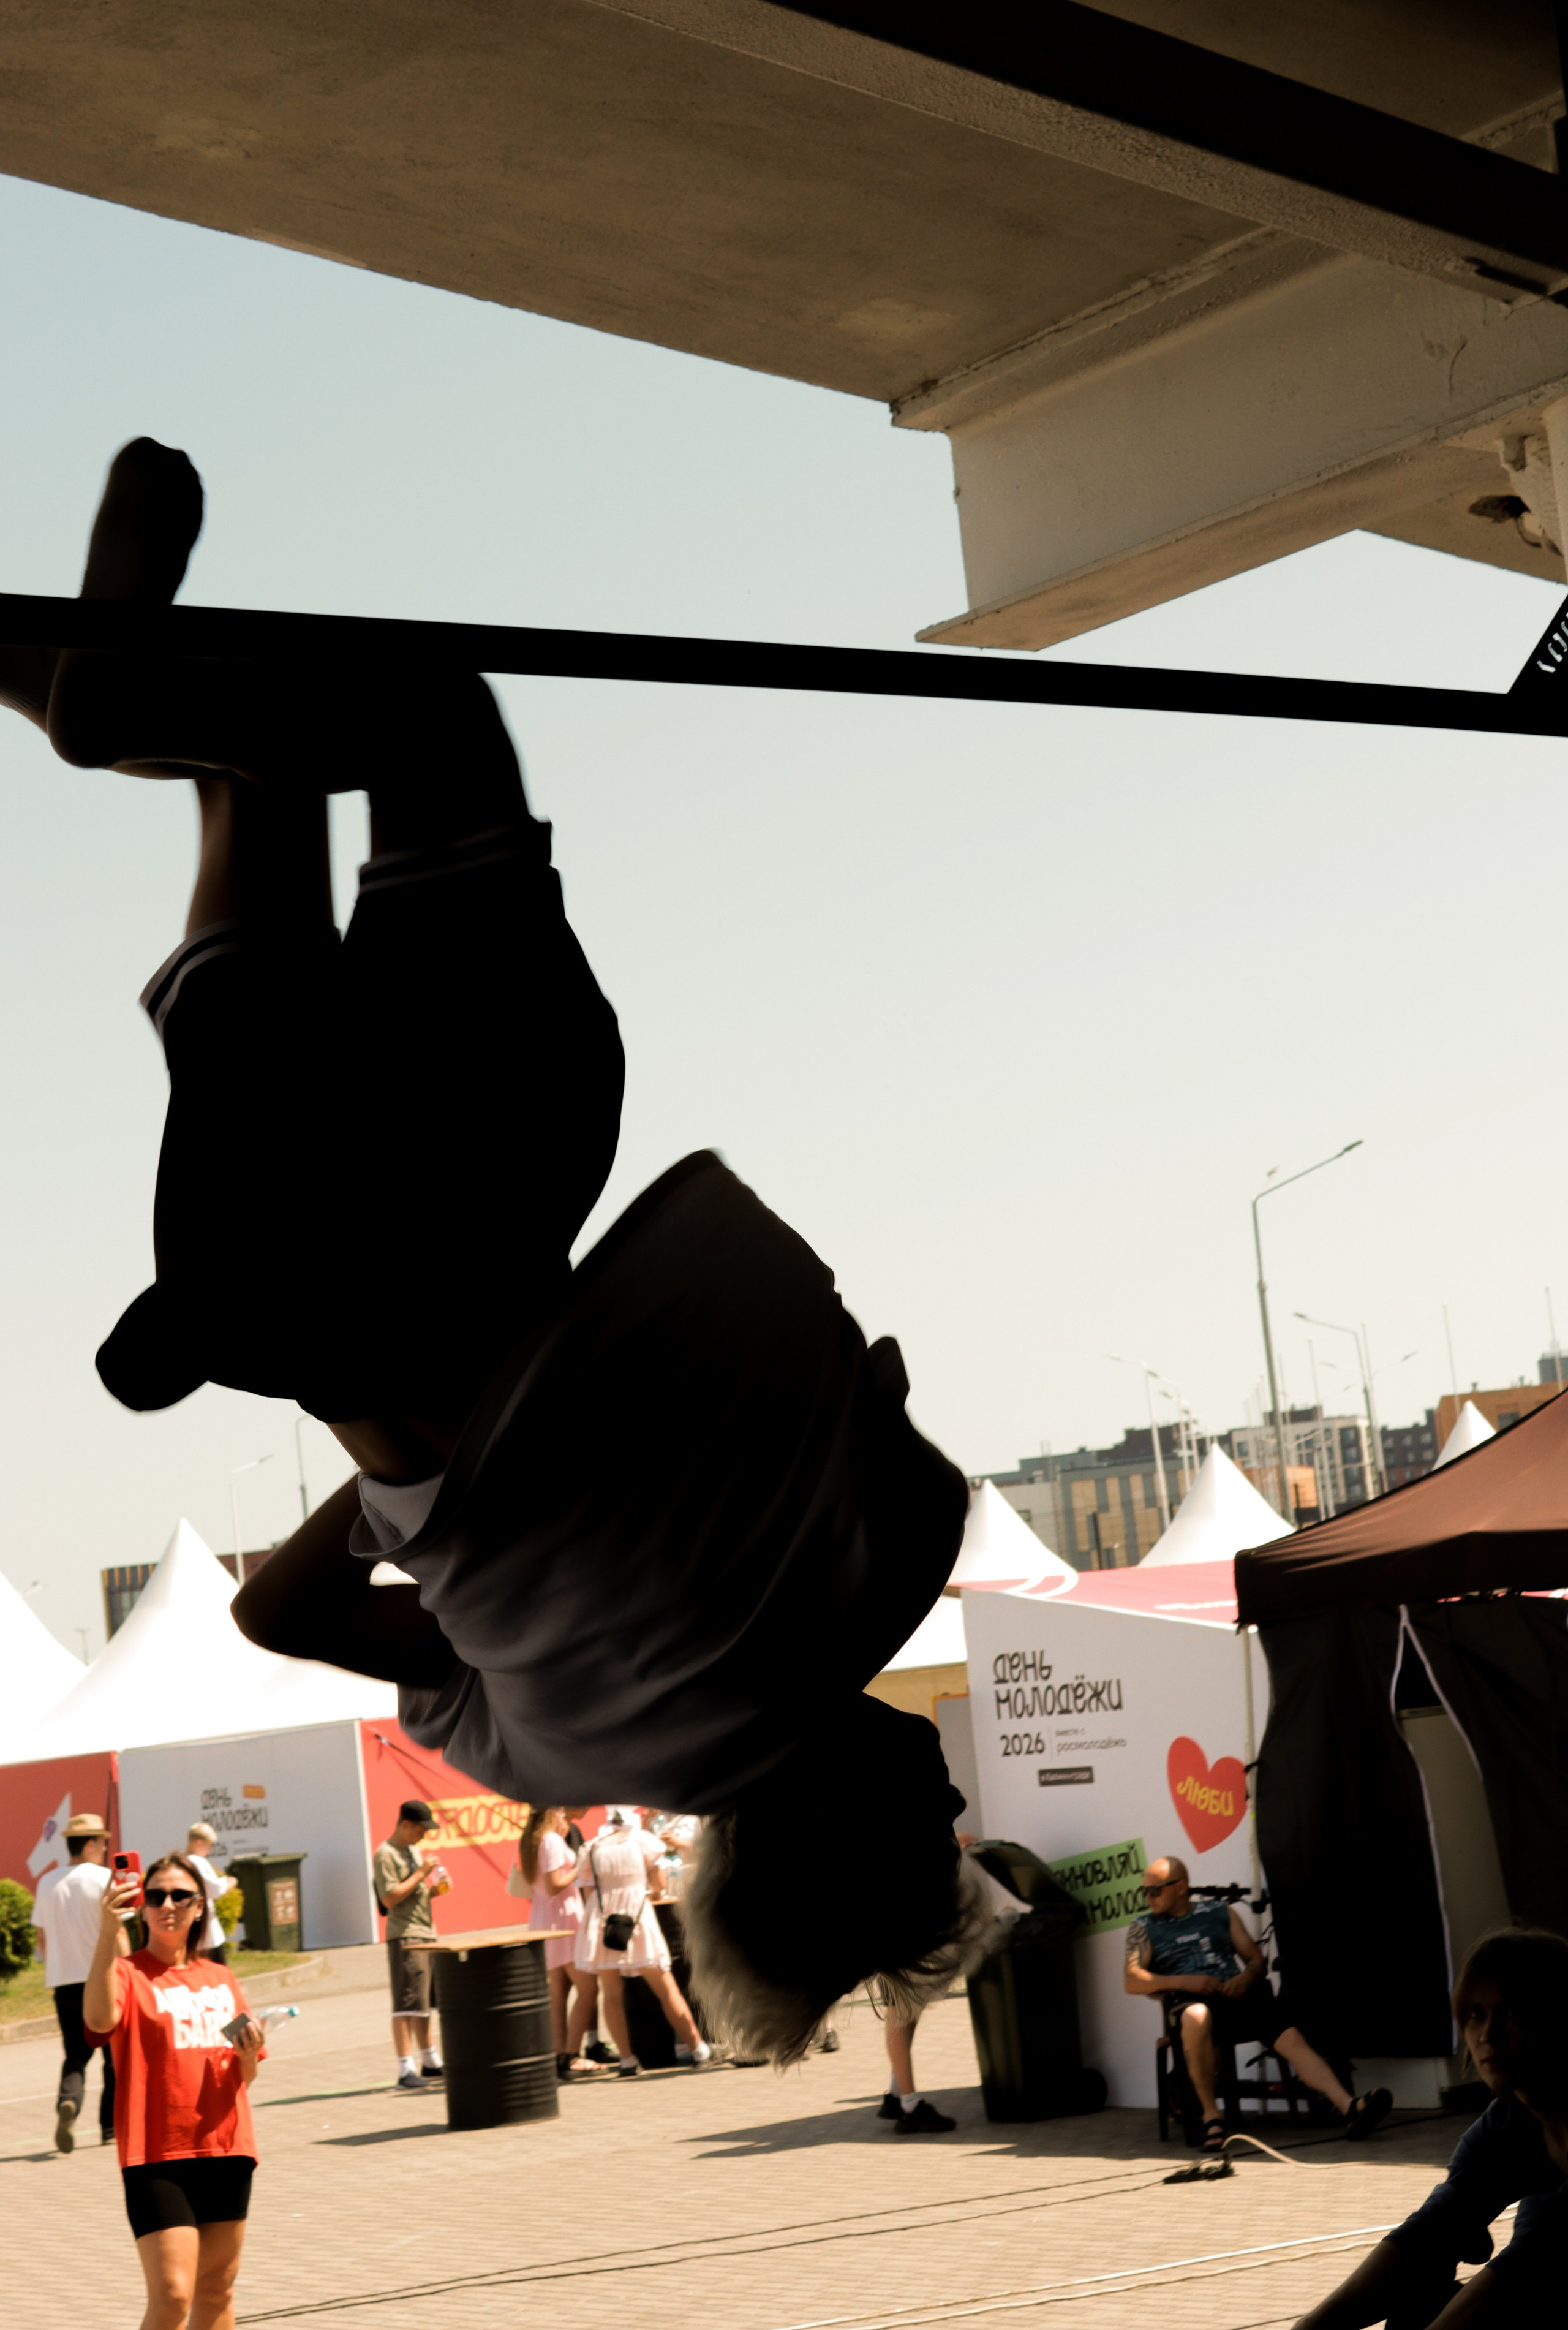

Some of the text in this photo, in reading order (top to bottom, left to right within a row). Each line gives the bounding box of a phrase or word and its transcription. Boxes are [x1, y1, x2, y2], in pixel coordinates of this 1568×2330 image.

[993, 1650, 1052, 1684] ДЕНЬ
[995, 1674, 1123, 1720] МОЛОДЁЖИ
[1000, 1733, 1046, 1757] 2026
[1176, 1775, 1234, 1817] ЛЮБИ
